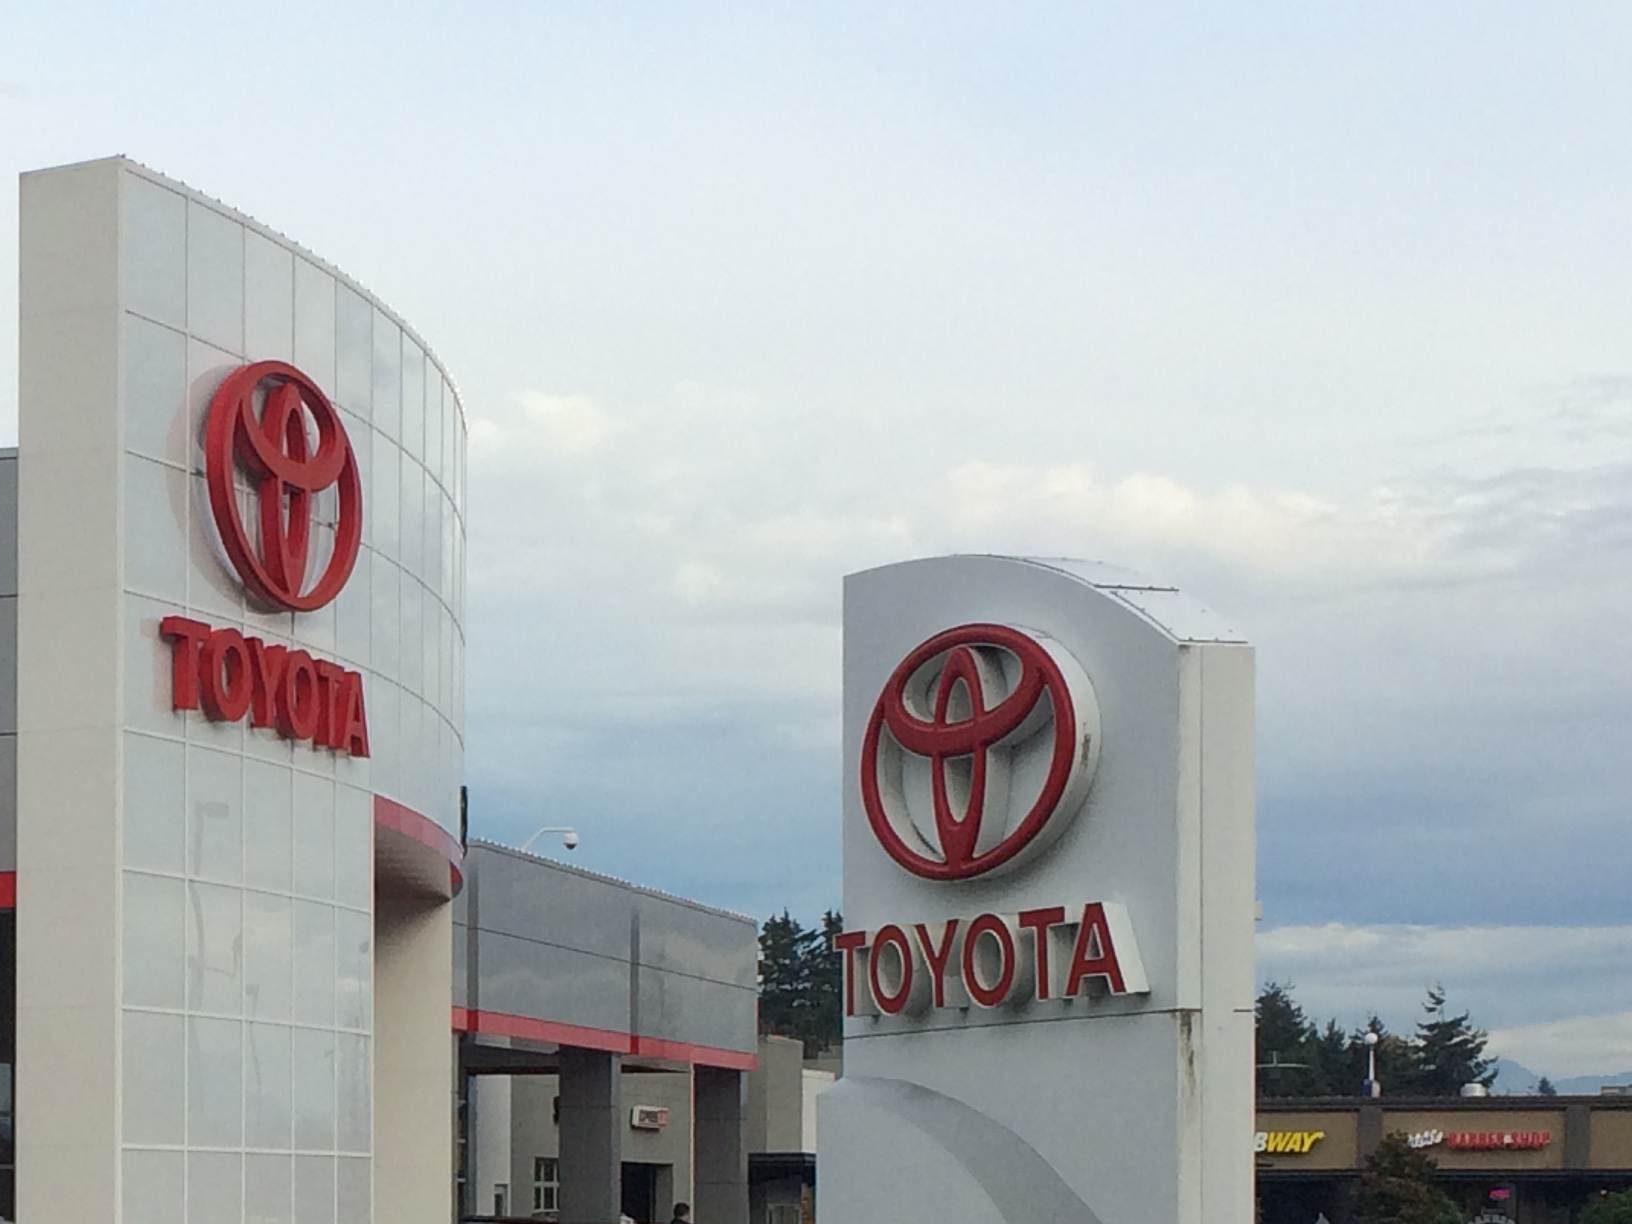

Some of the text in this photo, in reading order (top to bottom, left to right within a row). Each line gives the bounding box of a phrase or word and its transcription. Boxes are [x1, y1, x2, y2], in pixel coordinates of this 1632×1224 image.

[160, 616, 370, 758] TOYOTA
[834, 901, 1150, 1017] TOYOTA
[1254, 1131, 1326, 1153] BWAY
